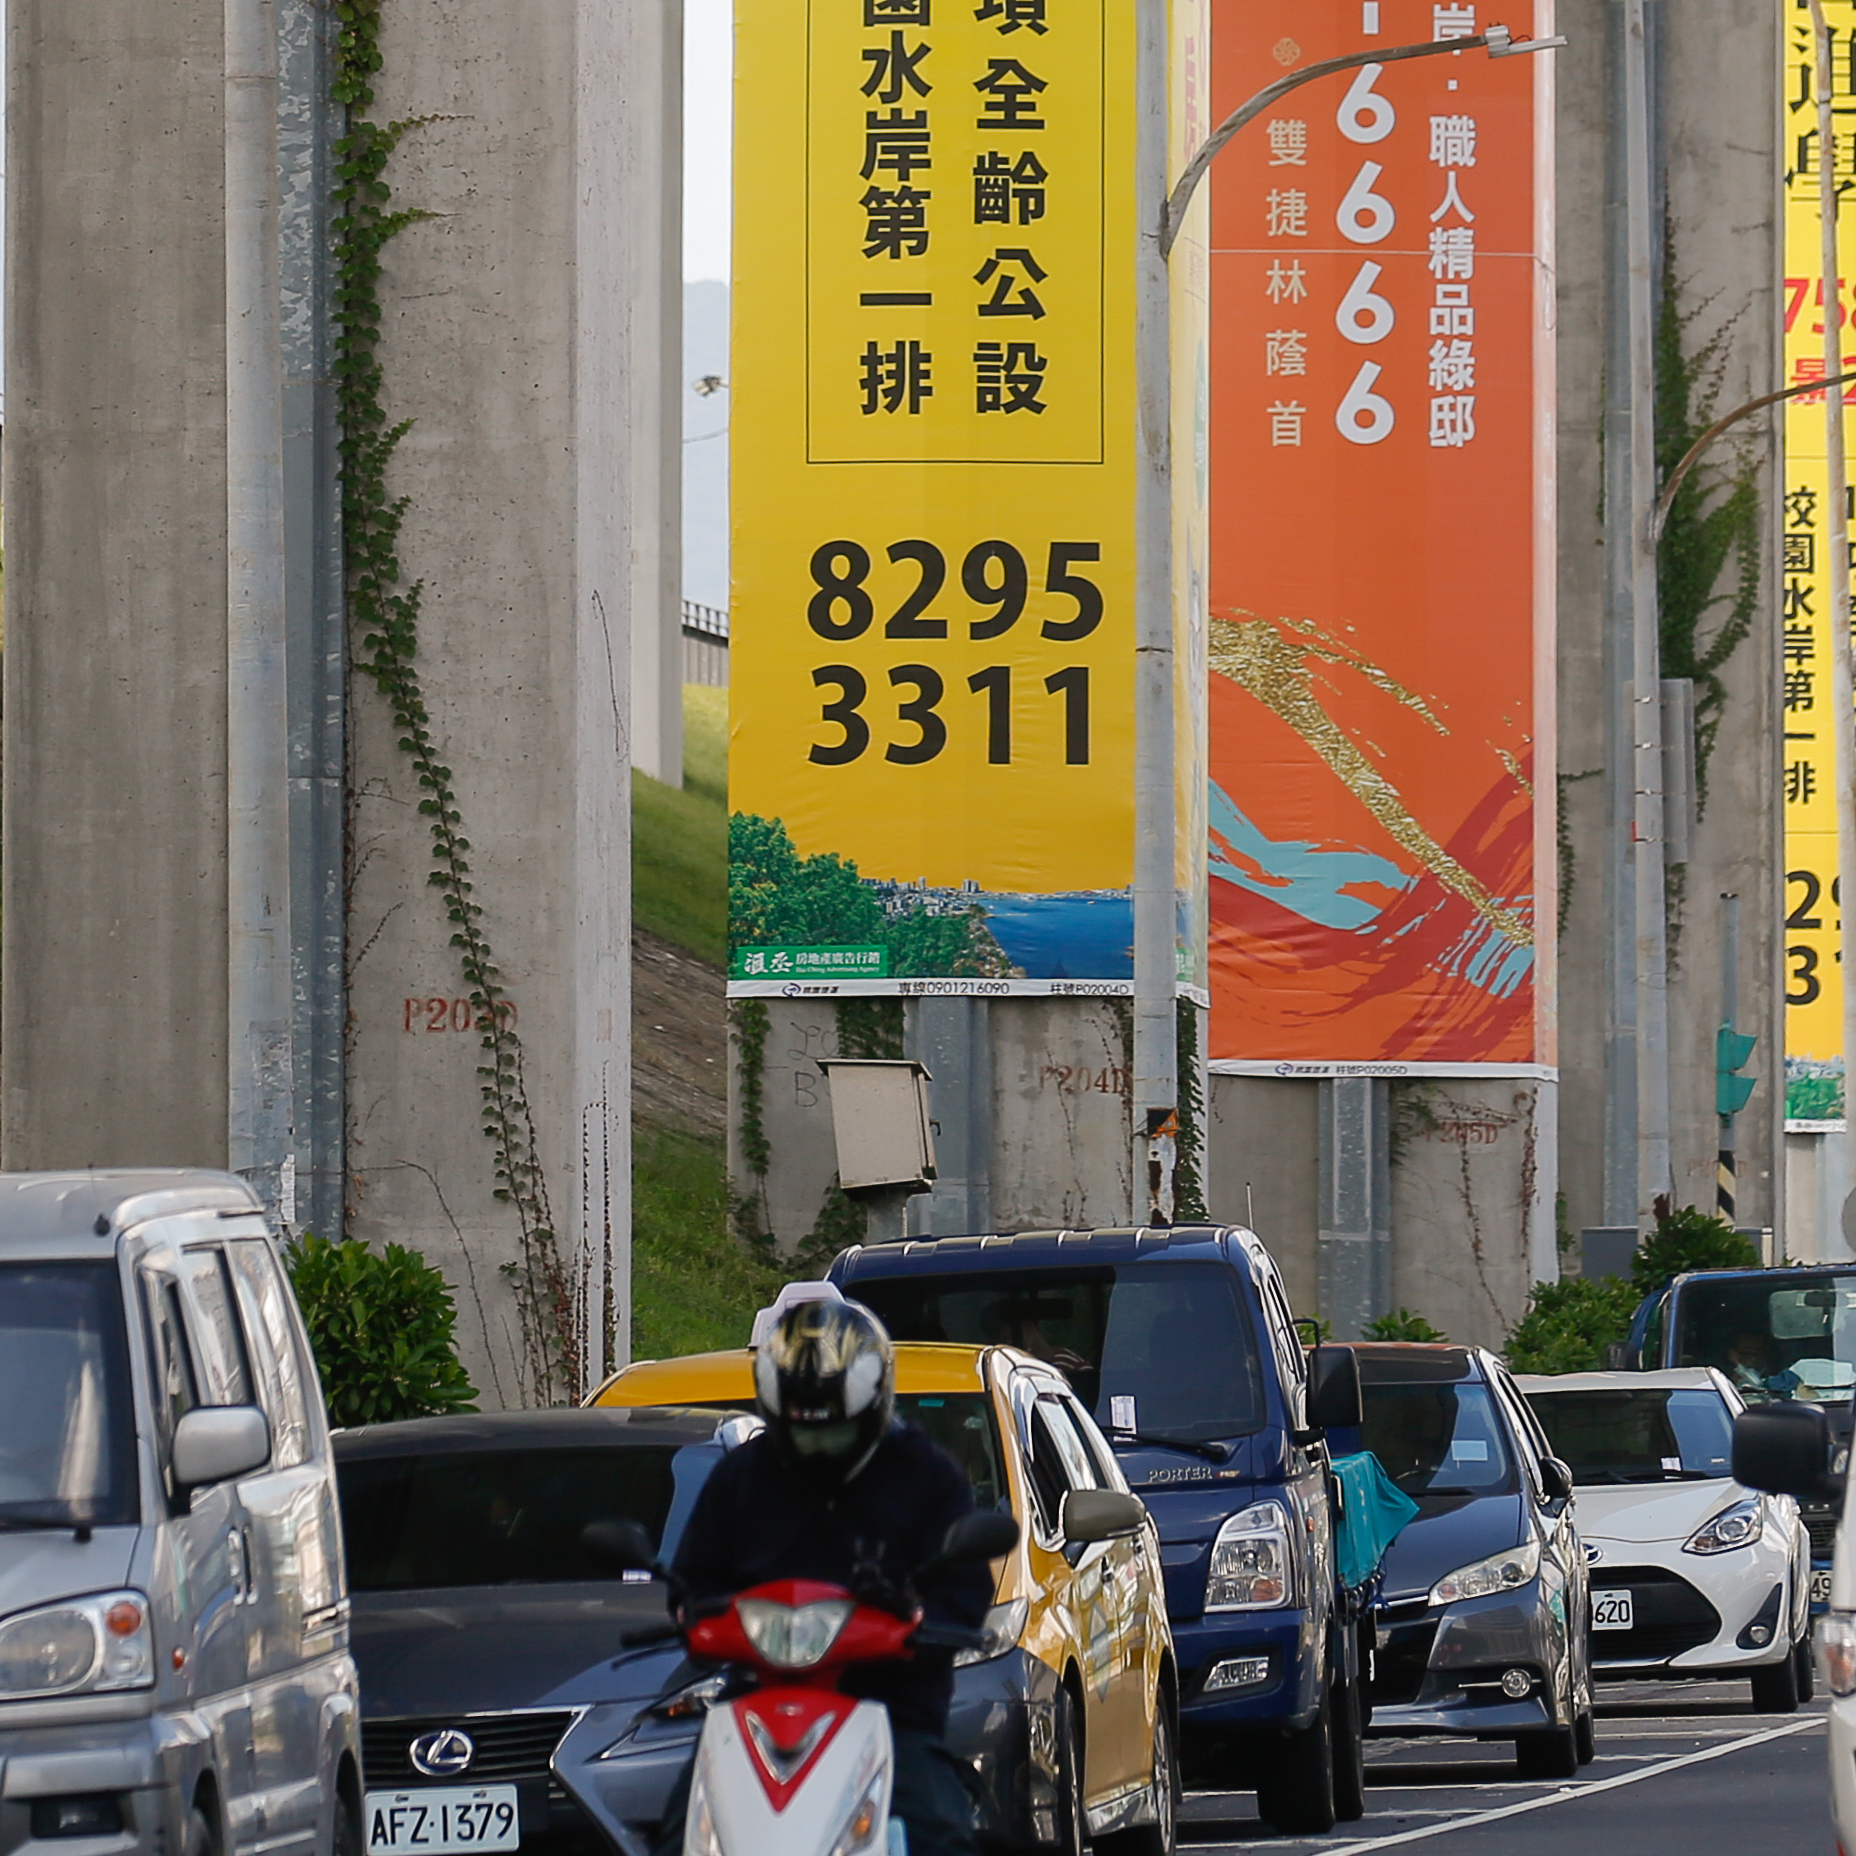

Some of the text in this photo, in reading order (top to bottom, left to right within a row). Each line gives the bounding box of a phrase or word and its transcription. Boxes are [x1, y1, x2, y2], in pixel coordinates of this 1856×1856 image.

[1266, 119, 1308, 447] 雙捷林蔭首
[807, 539, 1104, 641] 8295
[807, 664, 1089, 766] 3311
[1148, 1466, 1213, 1483] PORTER
